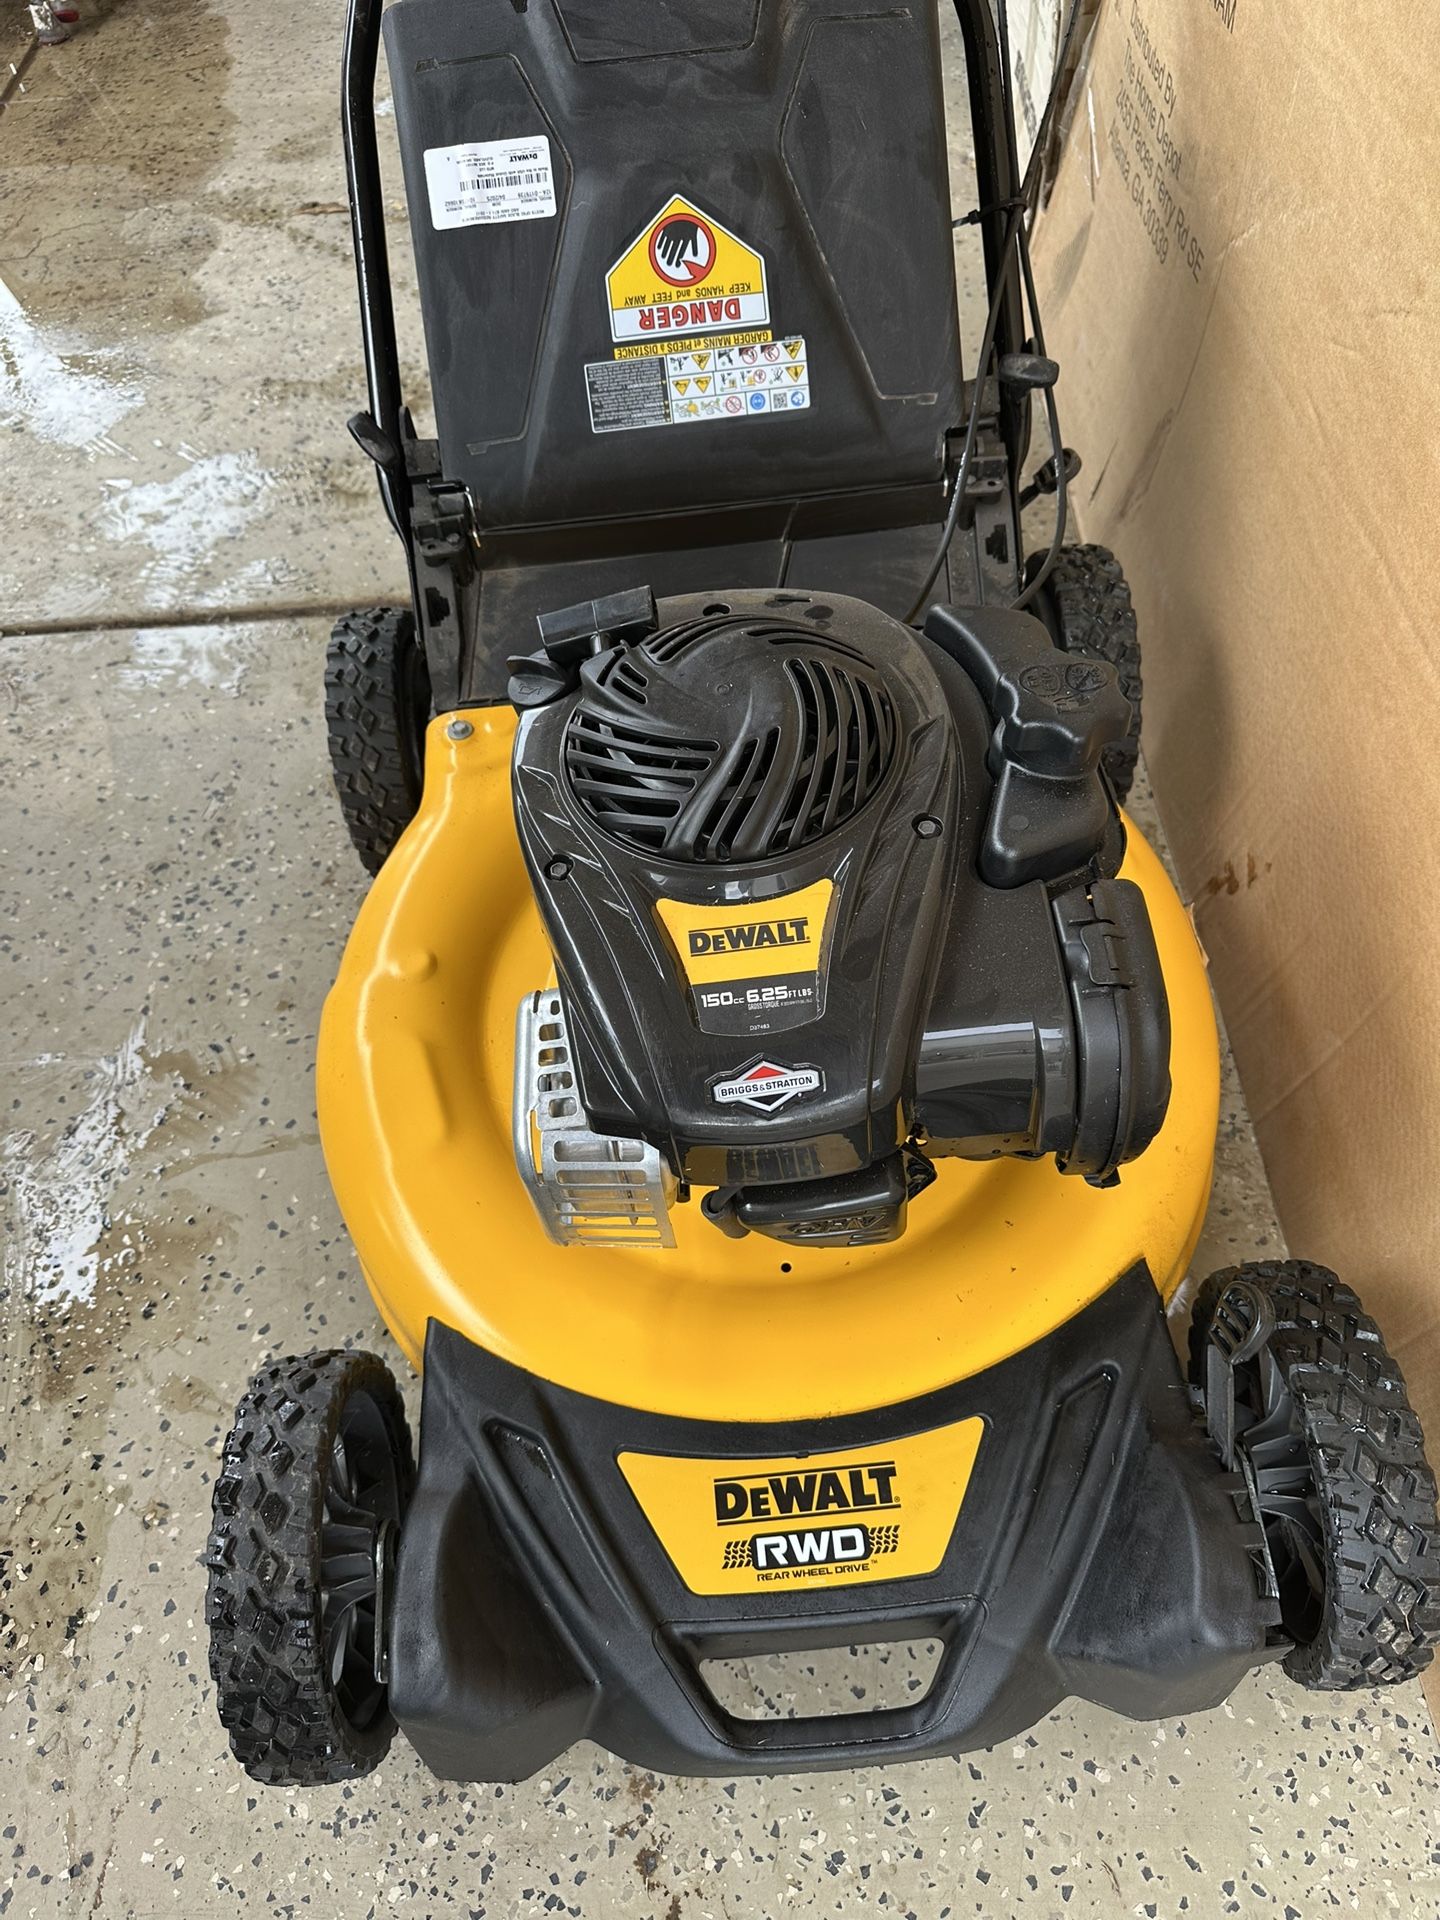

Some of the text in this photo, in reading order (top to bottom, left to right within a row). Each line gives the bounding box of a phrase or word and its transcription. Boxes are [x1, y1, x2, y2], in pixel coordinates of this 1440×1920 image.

[1164, 72, 1177, 118] By
[1134, 66, 1157, 129] Home
[1156, 112, 1183, 180] Depot
[1131, 114, 1154, 178] Paces
[1153, 162, 1176, 227] Ferry
[1174, 207, 1190, 251] Rd
[1187, 236, 1205, 283] SE
[1131, 172, 1145, 216] GA
[1143, 199, 1168, 264] 30339
[623, 282, 751, 307] KEEP HANDS and FEET AWAY
[638, 297, 742, 330] DANGER
[667, 340, 692, 354] PIEDS
[693, 339, 702, 349] et
[703, 335, 731, 349] MAINS
[733, 331, 769, 345] GARDER
[616, 345, 658, 358] DISTANCE
[756, 1528, 866, 1568] RWD
[757, 1562, 870, 1582] REAR WHEEL DRIVE
